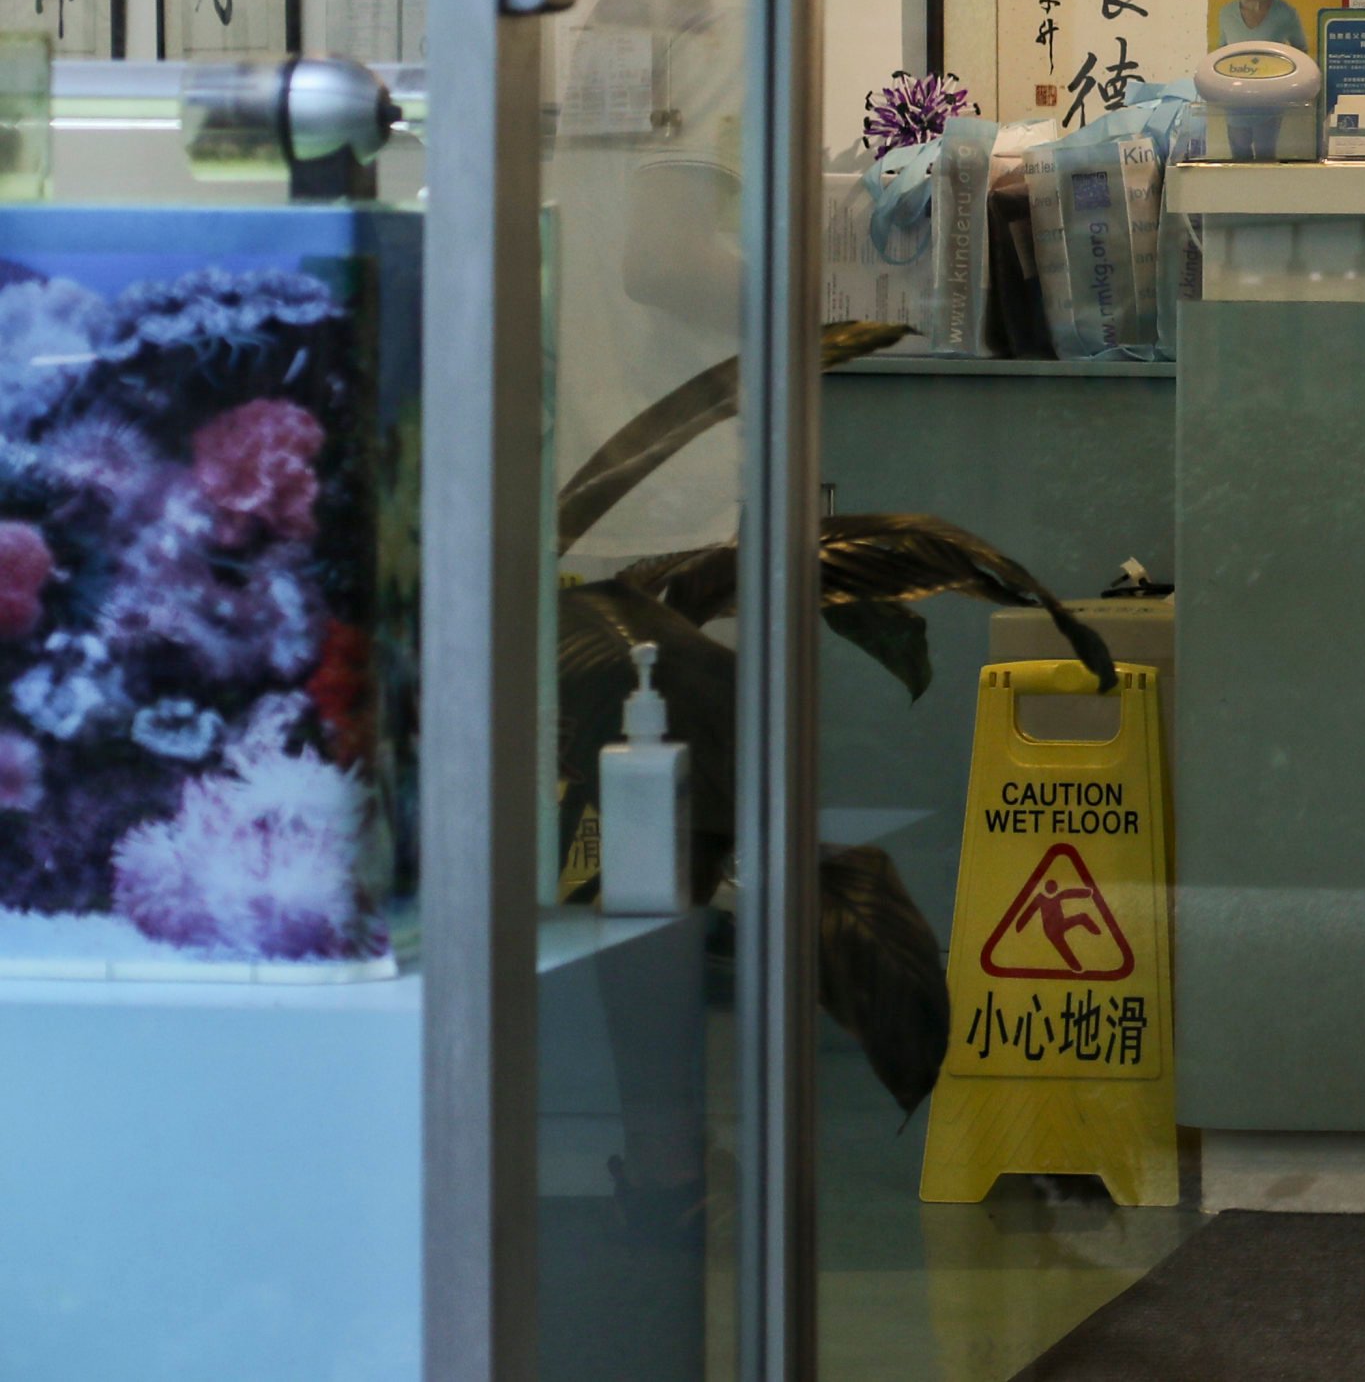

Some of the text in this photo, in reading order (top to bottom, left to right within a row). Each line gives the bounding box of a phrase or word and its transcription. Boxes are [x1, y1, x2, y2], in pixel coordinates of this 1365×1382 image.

[1001, 781, 1123, 807] CAUTION
[984, 809, 1140, 835] WET FLOOR
[966, 990, 1149, 1066] 小心地滑
